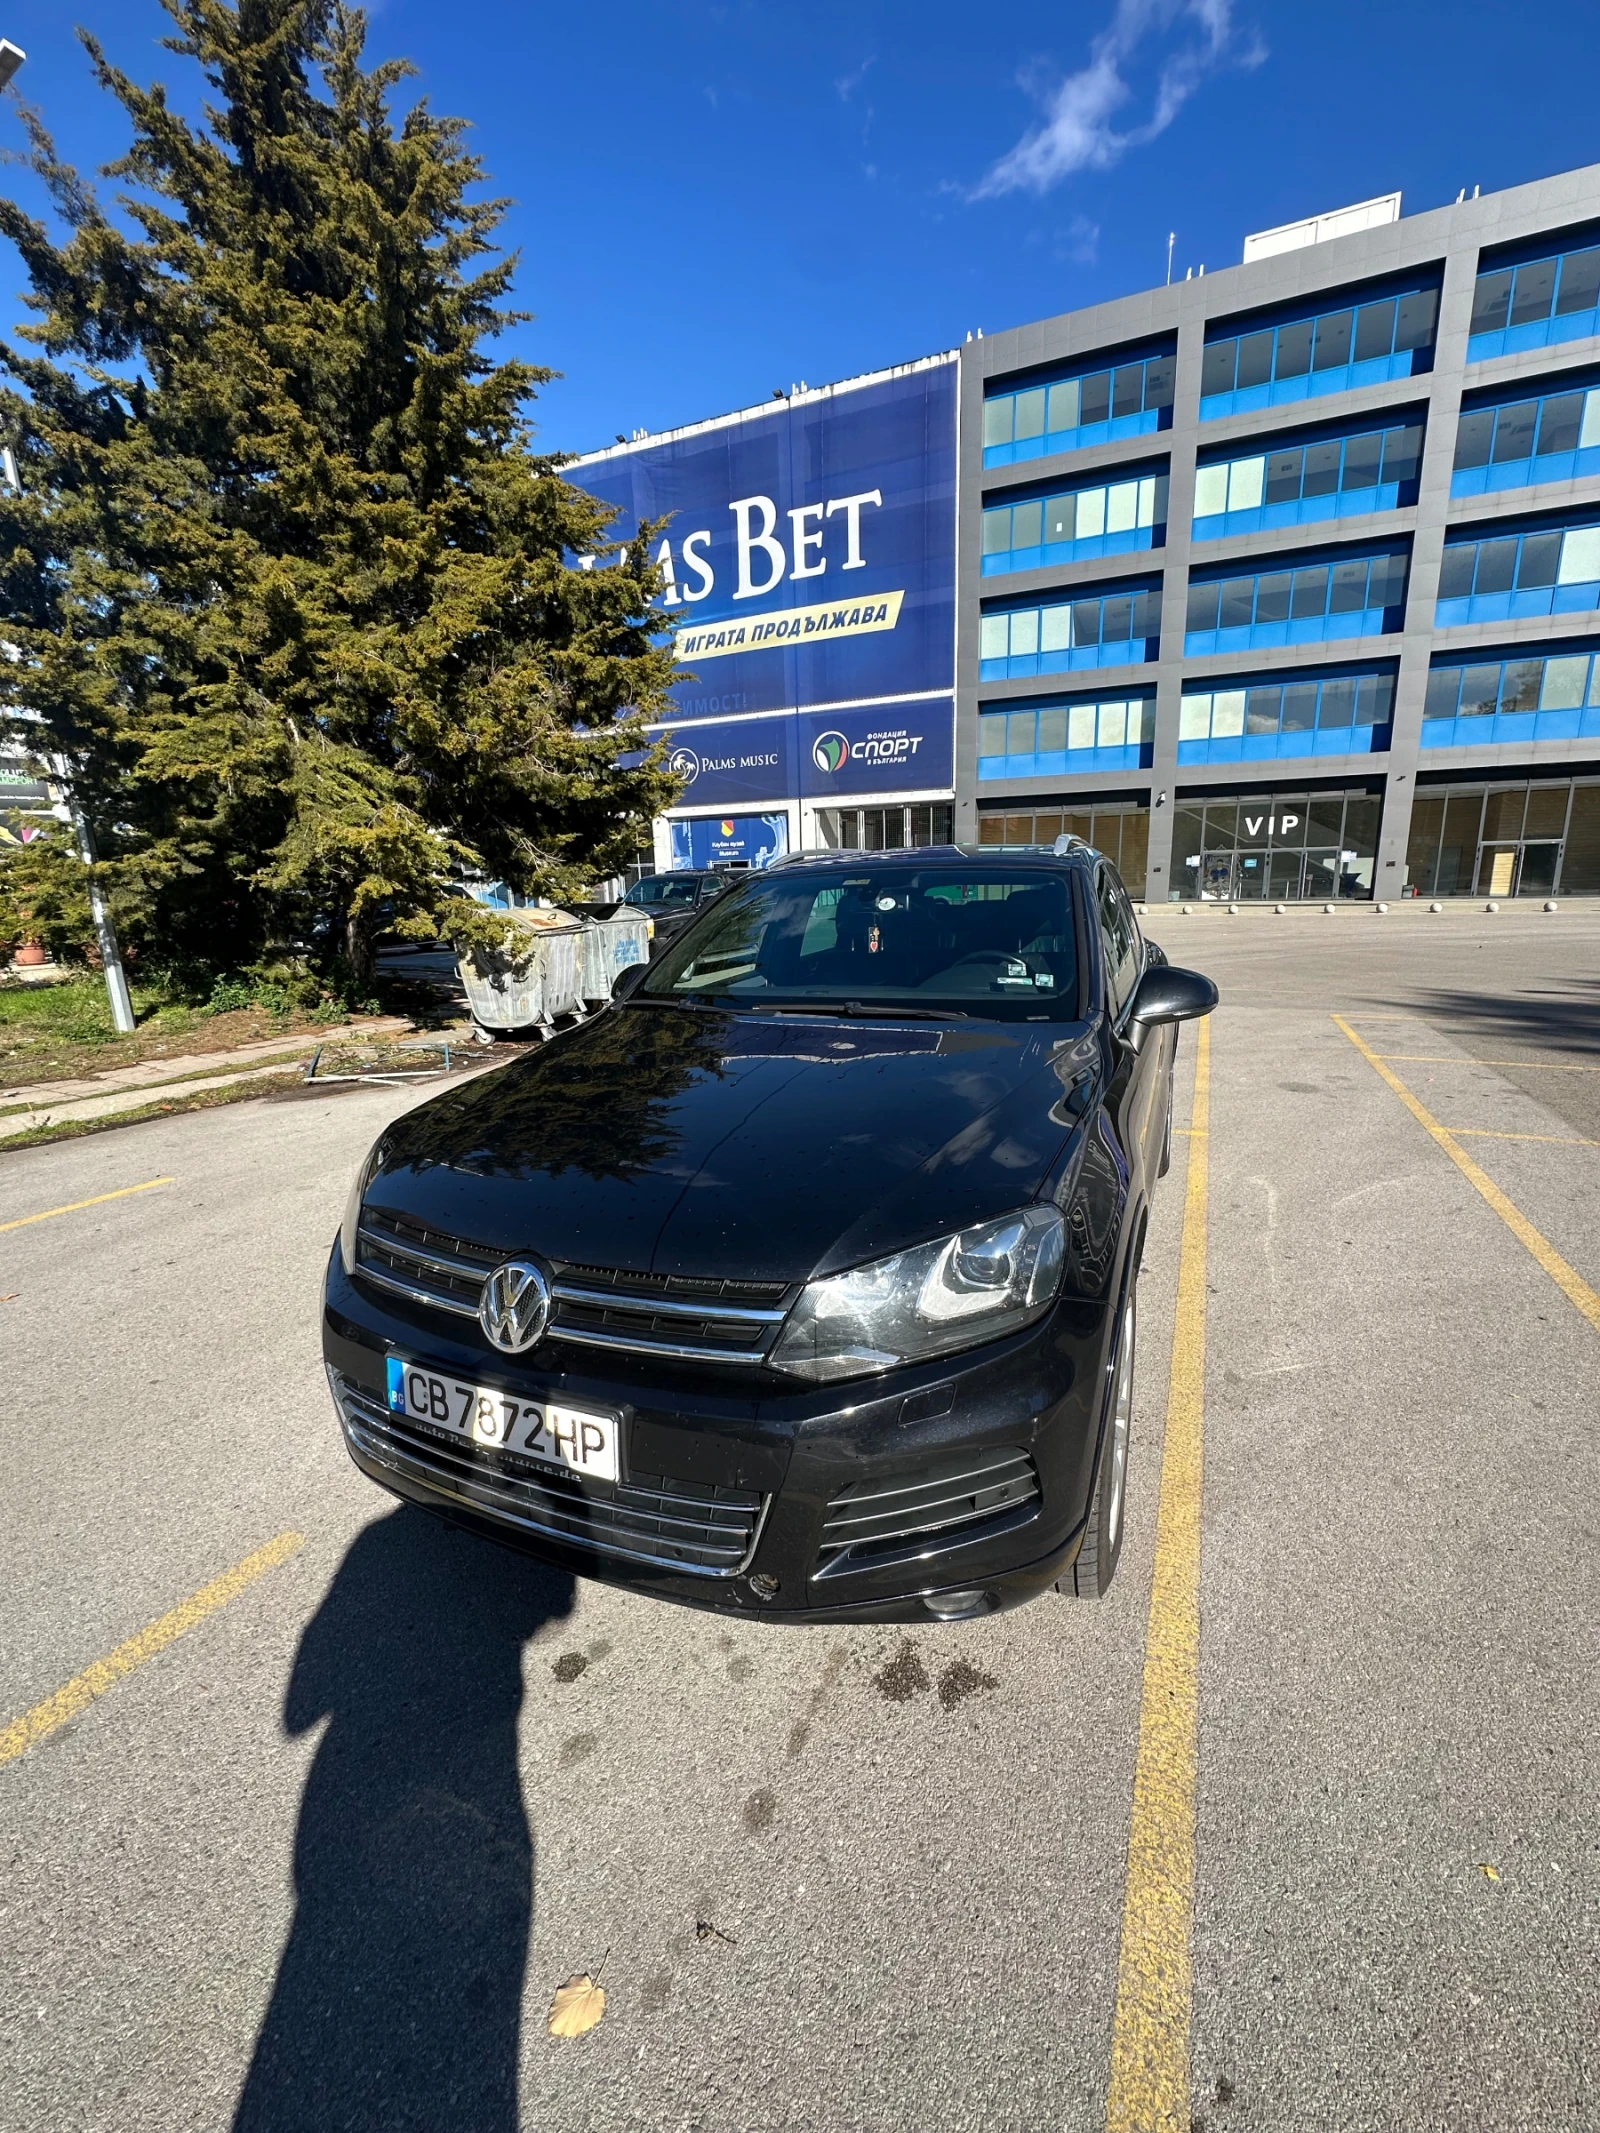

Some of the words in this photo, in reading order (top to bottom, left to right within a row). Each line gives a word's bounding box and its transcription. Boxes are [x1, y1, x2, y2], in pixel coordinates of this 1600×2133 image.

[728, 488, 883, 600] BET
[684, 627, 745, 654] ИГРАТА
[750, 603, 888, 642] ПРОДЪЛЖАВА
[867, 730, 907, 740] ФОНДАЦИЯ
[851, 737, 923, 758] СПОРТ
[1245, 815, 1299, 836] VIP
[391, 1390, 404, 1405] BG
